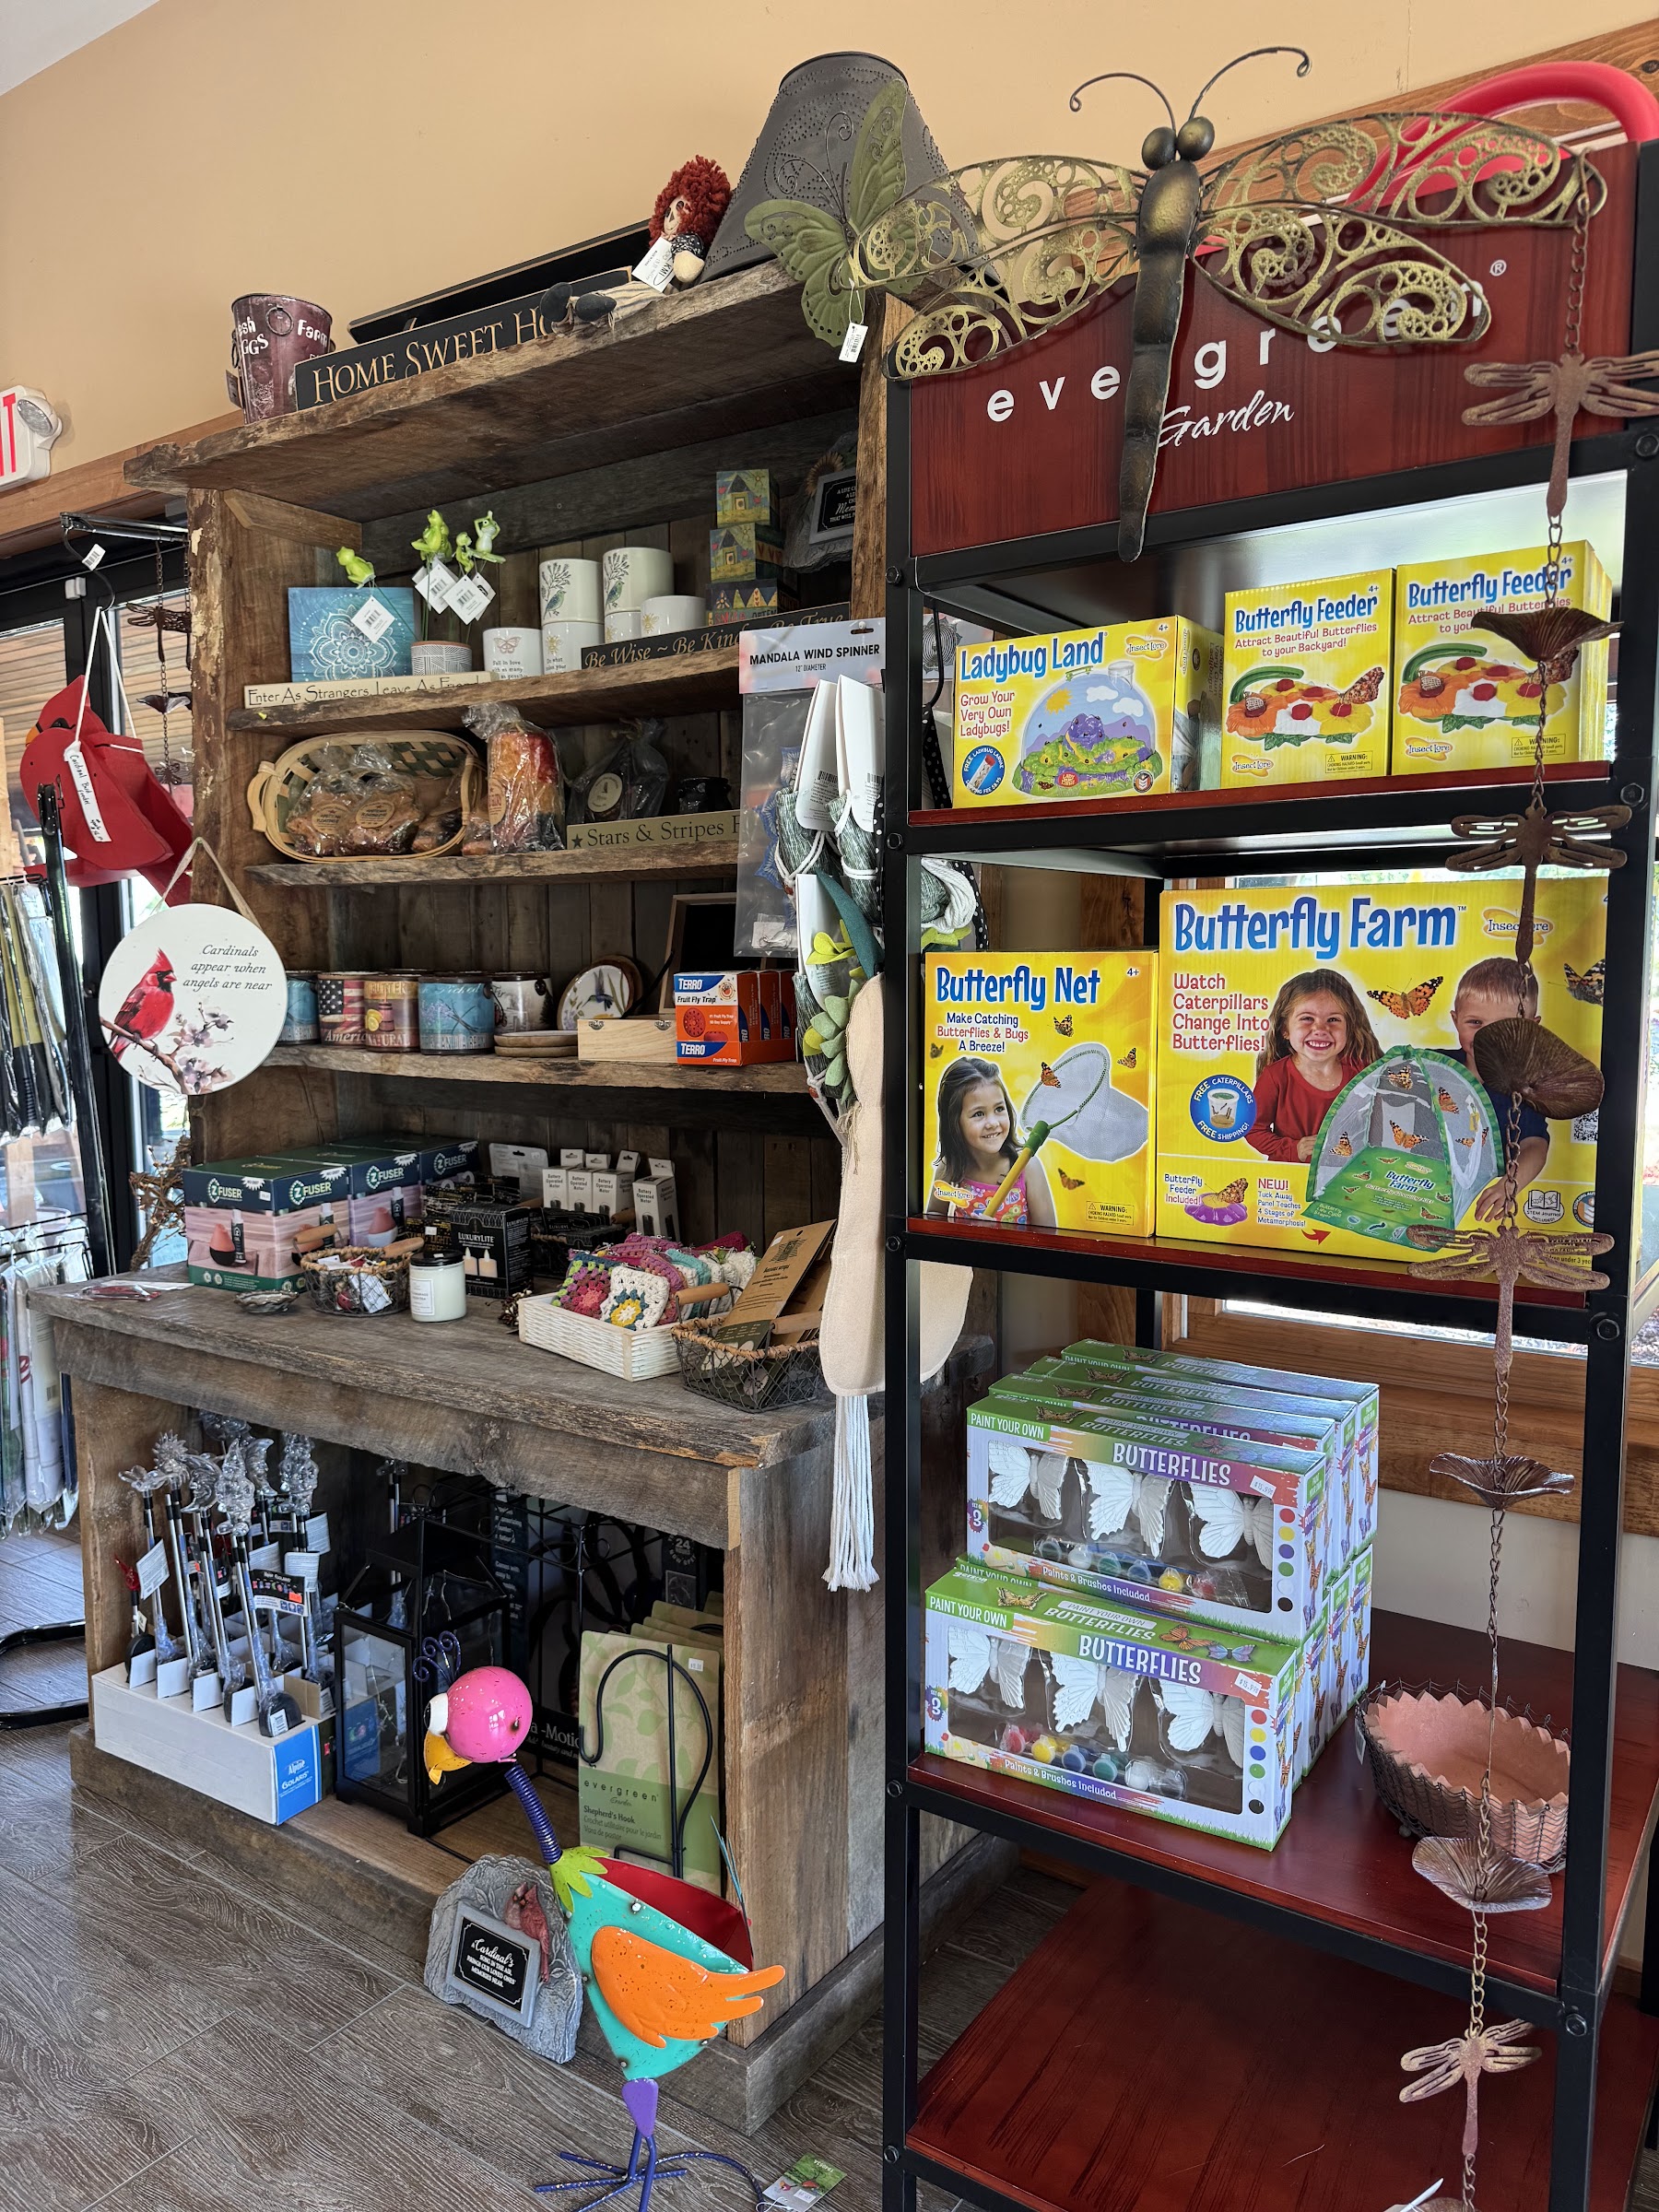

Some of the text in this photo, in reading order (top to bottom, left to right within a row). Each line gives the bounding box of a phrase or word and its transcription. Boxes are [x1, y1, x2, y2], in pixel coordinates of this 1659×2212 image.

[313, 323, 503, 405] HOME SWEET
[1408, 573, 1498, 608] Butterfly
[1235, 594, 1378, 633] Butterfly Feeder
[1408, 610, 1451, 625] Attract
[1159, 623, 1169, 631] 4+
[1235, 623, 1377, 649] Attract Beautiful Butterflies
[1440, 624, 1452, 633] to
[584, 636, 695, 669] Be Wise Be
[749, 644, 881, 665] MANDALA WIND SPINNER
[961, 631, 1105, 683] Ladybug Land
[1262, 638, 1347, 658] to your Backyard!
[803, 663, 827, 673] DIAMETER
[248, 686, 301, 706] Enter As
[960, 689, 1016, 707] Grow Your
[960, 706, 1012, 723] Very Own
[959, 720, 1010, 739] Ladybugs!
[964, 747, 994, 772] FREE LADYBUG
[1340, 753, 1369, 761] WARNING:
[586, 828, 630, 847] Stars
[636, 823, 655, 842] &
[660, 820, 724, 842] Stripes
[1174, 896, 1457, 959] Butterfly Farm
[202, 944, 259, 958] Cardinals
[191, 961, 266, 974] appear when
[1126, 968, 1140, 977] 4+
[182, 977, 273, 993] angels are near
[678, 979, 703, 991] TERRO
[936, 965, 1100, 1011] Butterfly Net
[1173, 972, 1226, 992] Watch
[677, 995, 716, 1004] Fruit Fly Trap
[1172, 993, 1269, 1014] Caterpillars
[947, 1012, 1018, 1029] Make Catching
[1172, 1013, 1271, 1035] Change Into
[936, 1026, 1030, 1042] Butterflies & Bugs
[1172, 1032, 1265, 1053] Butterflies!
[681, 1042, 706, 1055] TERRO
[959, 1041, 1006, 1053] A Breeze!
[1194, 1077, 1253, 1104] FREE CATERPILLARS
[1197, 1120, 1251, 1140] FREE SHIPPING!
[1164, 1173, 1203, 1187] Butterfly
[1169, 1183, 1197, 1194] Feeder
[1258, 1178, 1289, 1191] NEW!
[1386, 1171, 1435, 1191] Butterfly
[1389, 1180, 1419, 1194] Farm
[937, 1187, 957, 1198] Insect
[1165, 1193, 1202, 1206] Included!
[1258, 1190, 1293, 1202] Tuck Away
[1100, 1204, 1128, 1213] WARNING:
[1257, 1199, 1301, 1210] Panel Teaches
[1264, 1208, 1285, 1218] Stages
[1286, 1209, 1295, 1218] of
[1257, 1216, 1306, 1228] Metamorphosis!
[1100, 1396, 1206, 1418] BUTTERFLIES
[971, 1413, 1044, 1439] PAINT YOUR OWN
[1079, 1420, 1188, 1448] BUTTERFLIES
[1103, 1418, 1180, 1438] PAINT YOUR OWN
[1112, 1442, 1231, 1487] BUTTERFLIES
[972, 1509, 982, 1527] 3
[1042, 1566, 1151, 1603] Paints & Brushes Included
[930, 1595, 1007, 1628] PAINT YOUR OWN
[1067, 1602, 1147, 1627] PAINT YOUR OWN
[1043, 1607, 1157, 1641] BUTTERFLIES
[1079, 1634, 1202, 1685] BUTTERFLIES
[931, 1698, 941, 1715] 3
[1005, 1759, 1118, 1800] Paints & Brushes Included
[583, 1780, 657, 1803] evergreen
[583, 1805, 636, 1824] Shepherd's Hook
[583, 1815, 662, 1841] Crochet utilitaire pour jardin
[475, 1938, 515, 1968] Cardinal's
